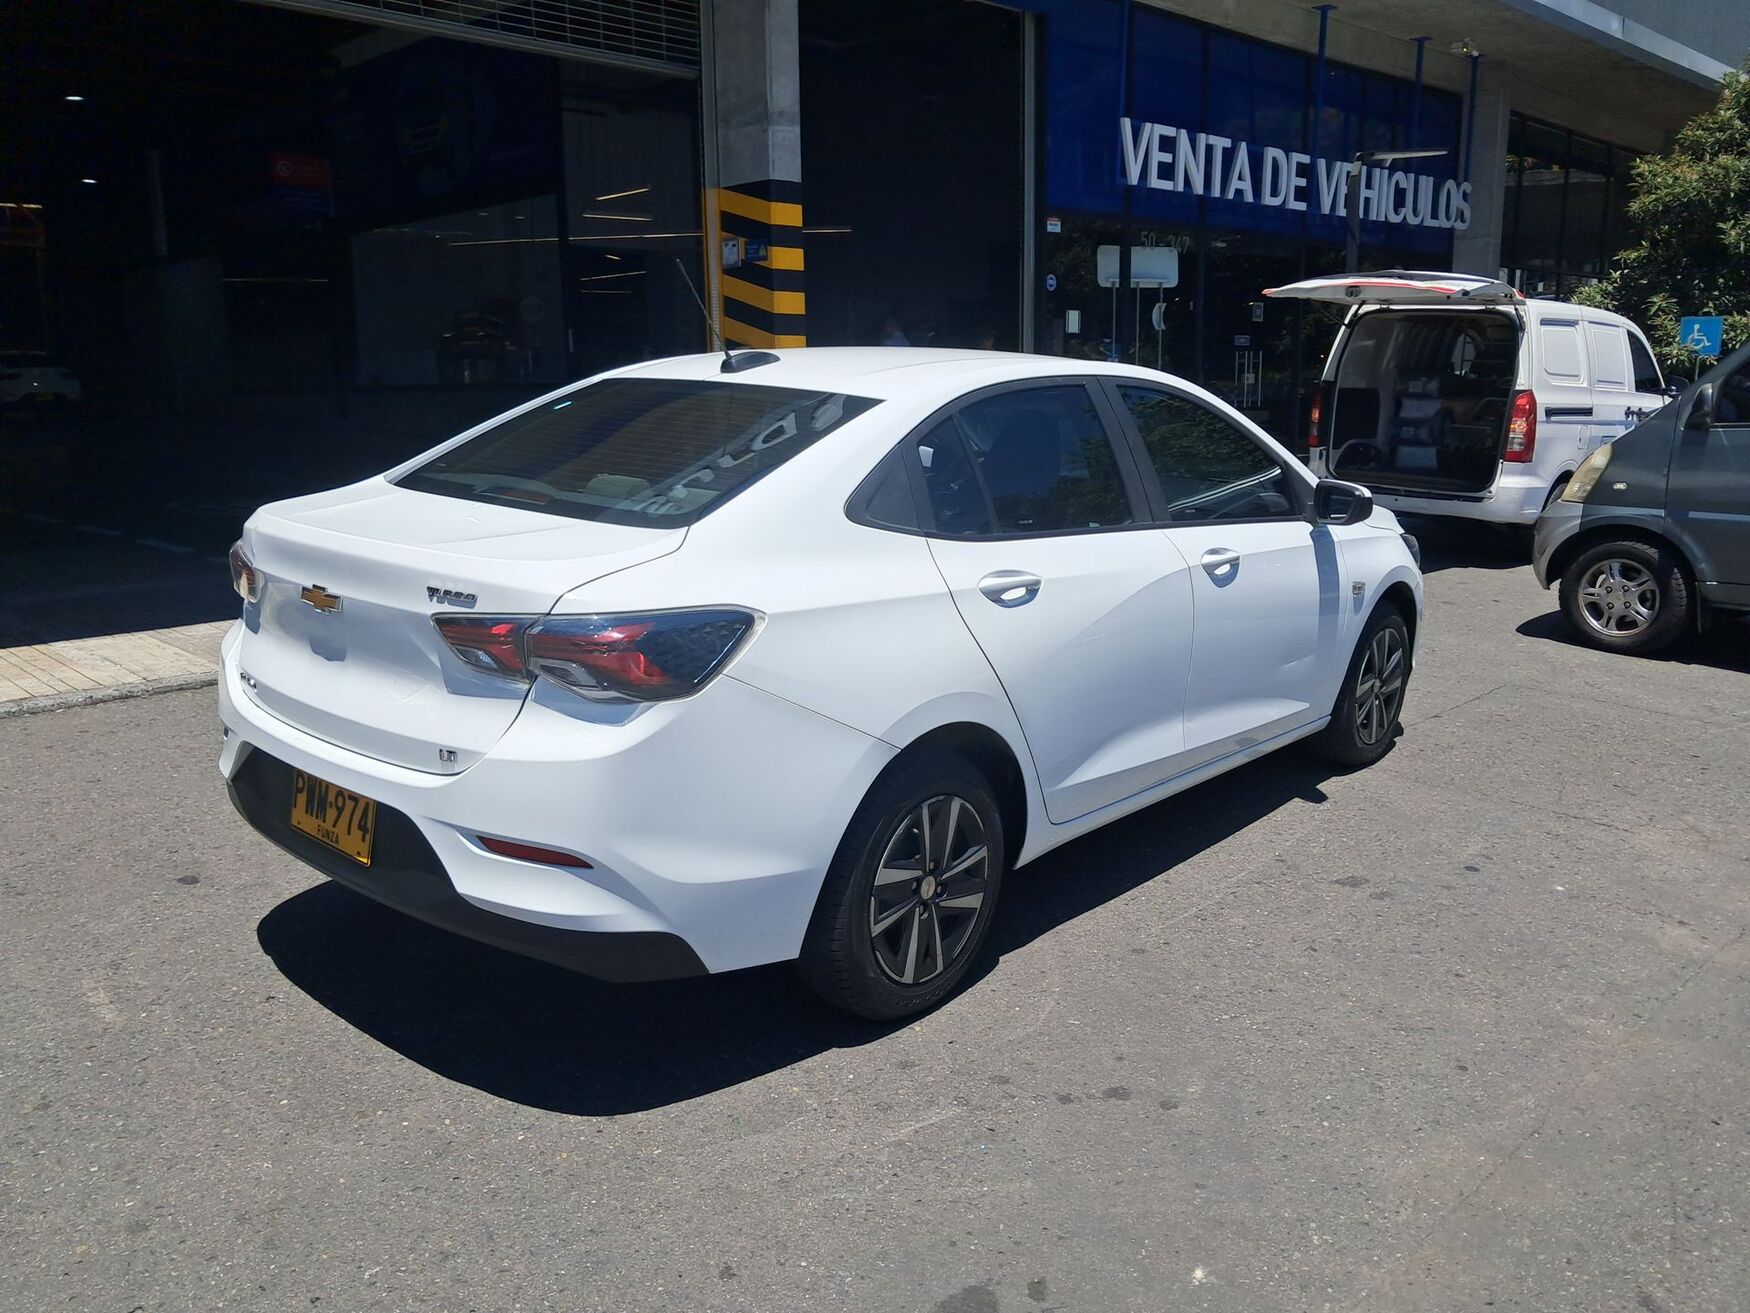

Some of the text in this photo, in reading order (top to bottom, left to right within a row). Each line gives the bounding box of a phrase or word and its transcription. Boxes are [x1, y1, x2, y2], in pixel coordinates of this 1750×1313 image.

[1120, 117, 1254, 202] VENTA
[1261, 146, 1311, 211] DE
[316, 824, 340, 846] FUNZA
